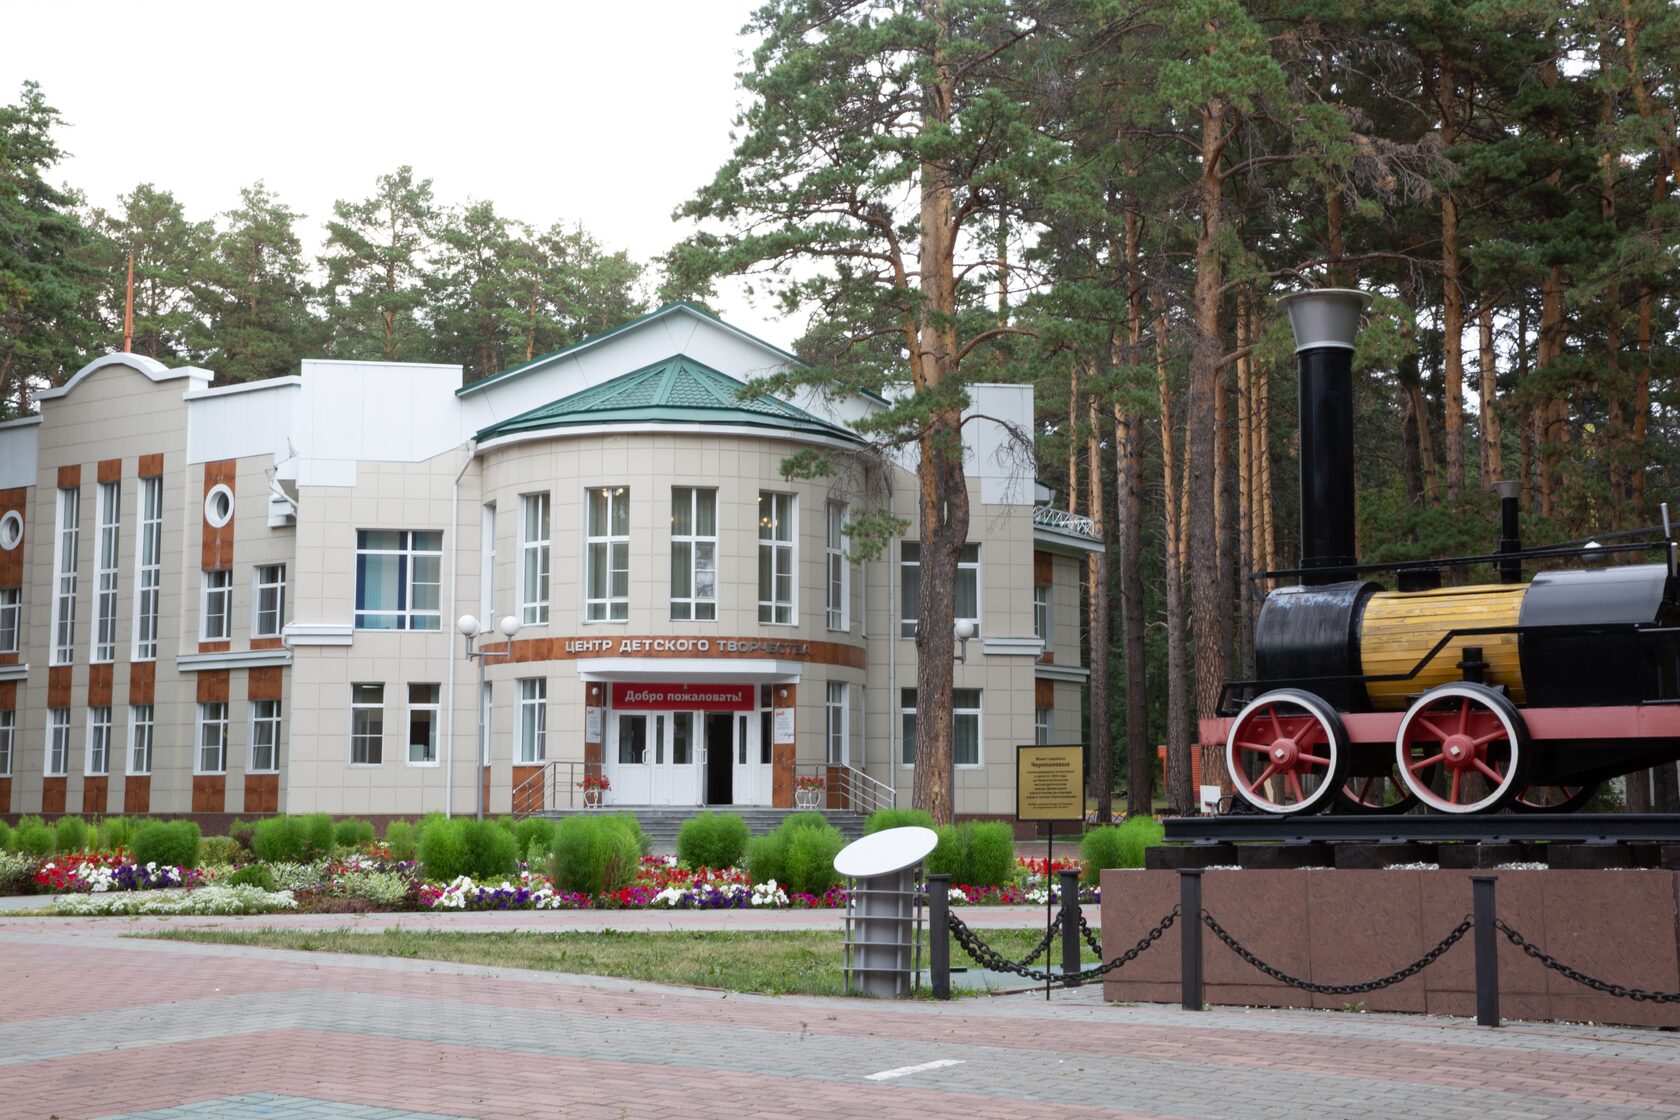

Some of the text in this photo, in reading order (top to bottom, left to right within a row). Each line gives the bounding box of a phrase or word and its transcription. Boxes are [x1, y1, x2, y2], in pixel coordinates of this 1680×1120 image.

[565, 640, 613, 653] ЦЕНТР
[620, 639, 709, 653] ДЕТСКОГО
[625, 691, 742, 703] Добро пожаловать!
